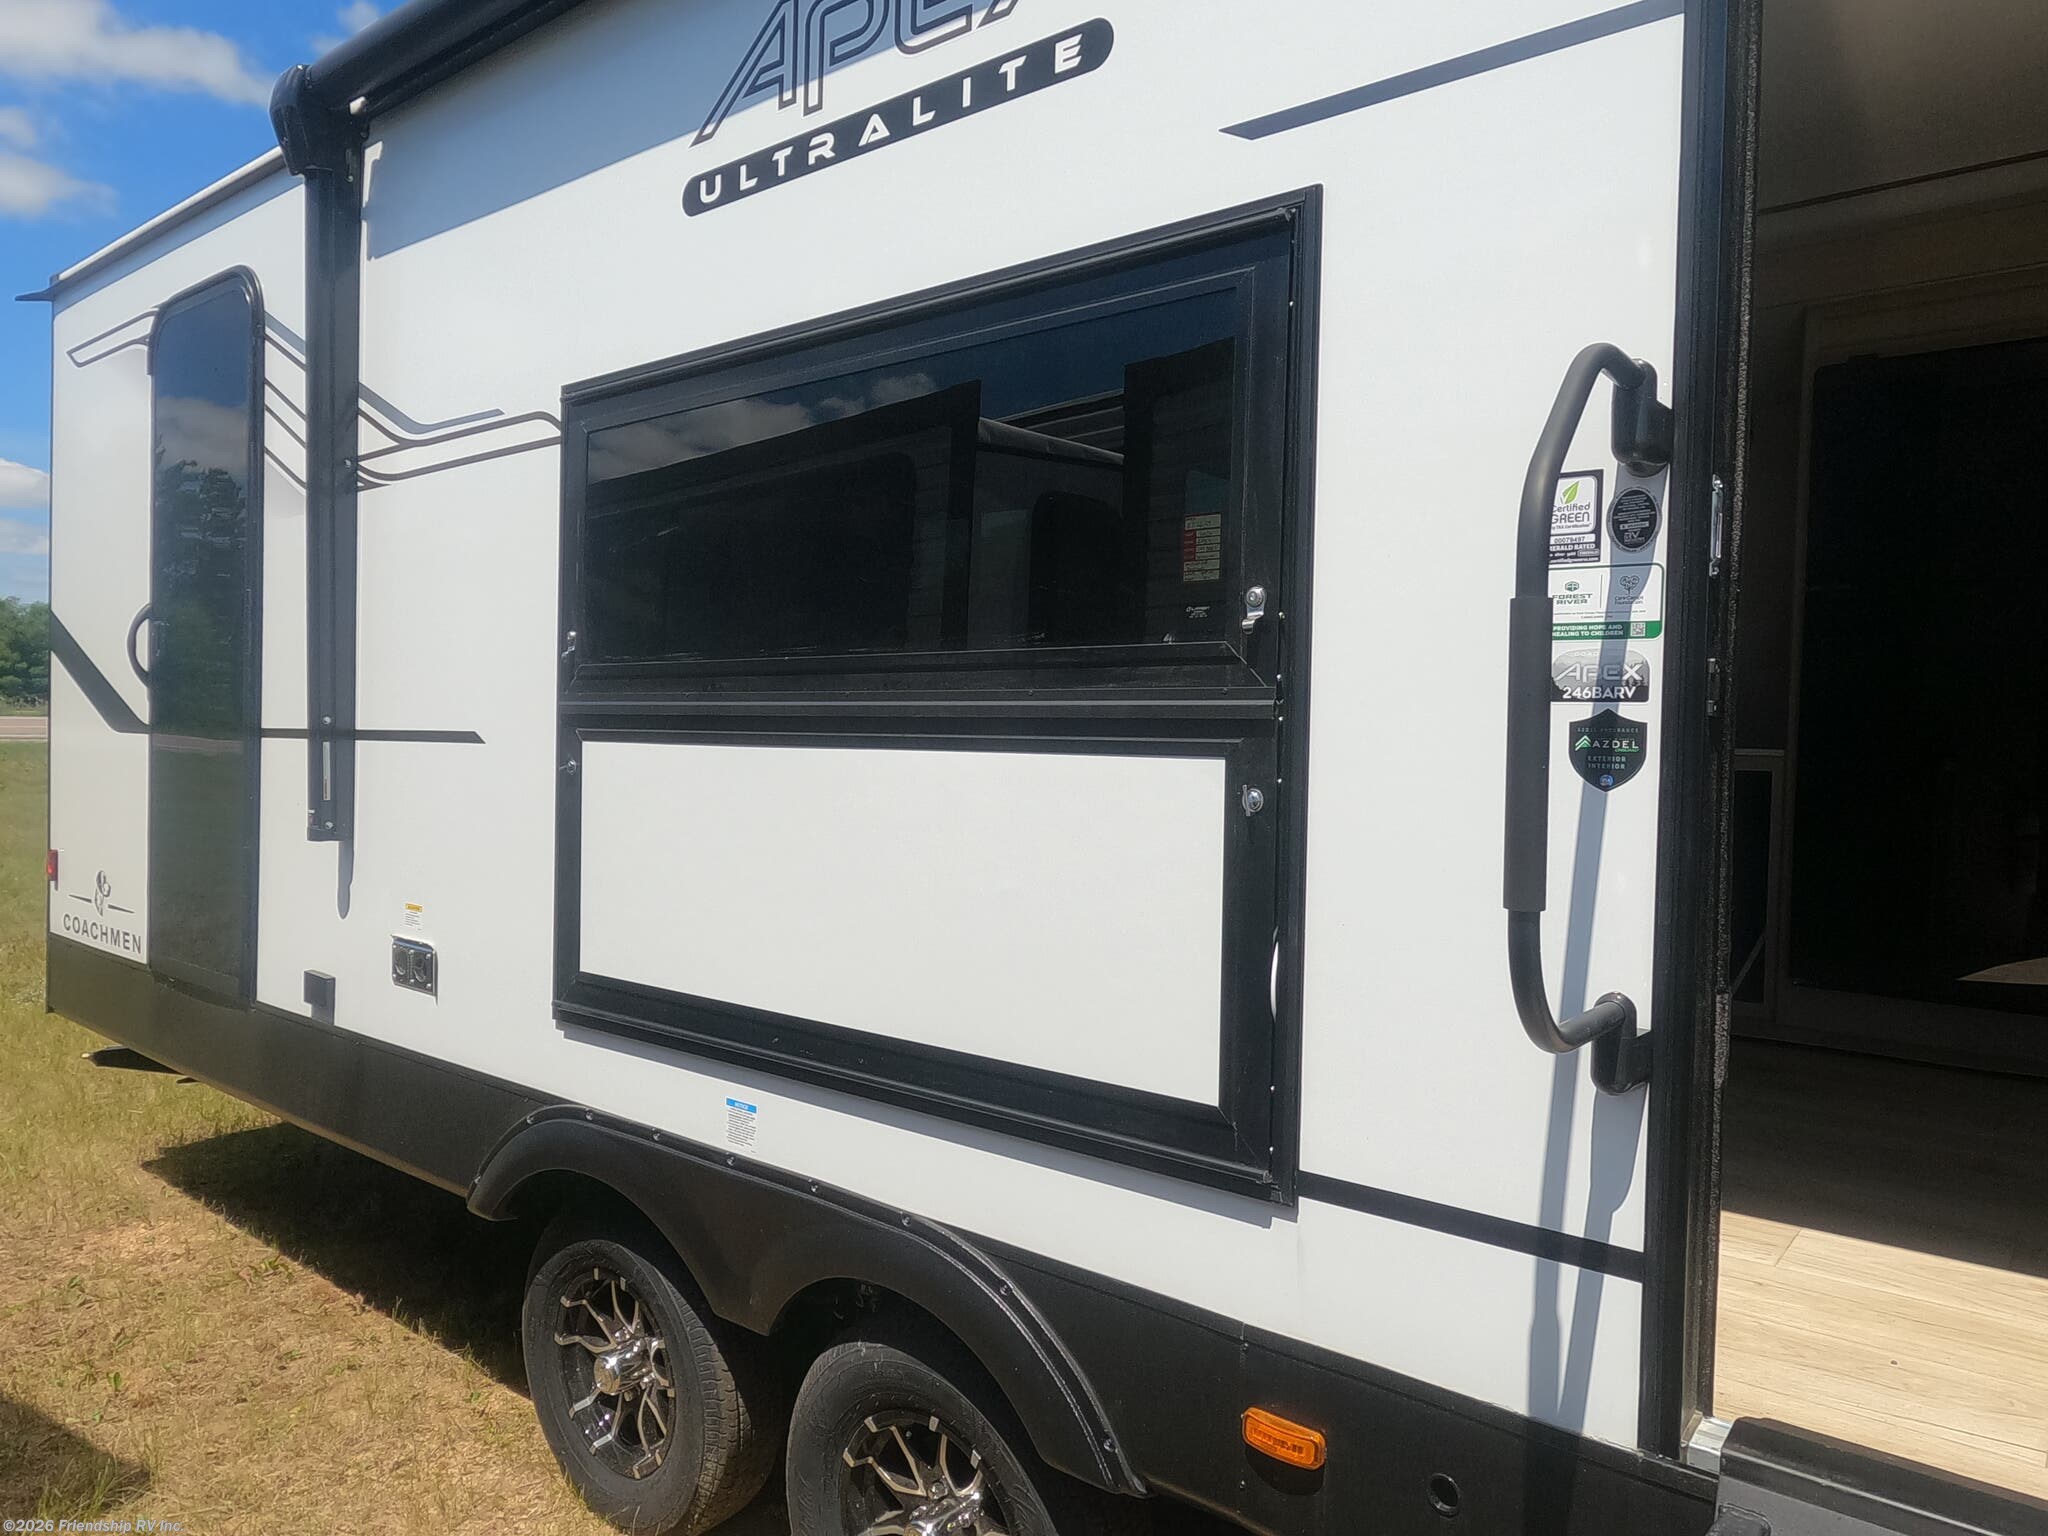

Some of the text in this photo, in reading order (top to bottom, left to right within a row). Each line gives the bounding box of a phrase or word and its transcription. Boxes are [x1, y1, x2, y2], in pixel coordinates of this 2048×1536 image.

[698, 32, 1085, 204] ULTRALITE
[1552, 501, 1591, 513] Certified
[1551, 511, 1590, 525] GREEN
[1550, 544, 1574, 552] ERALD
[1553, 624, 1588, 632] PROVIDING
[1554, 663, 1643, 683] APEX
[1562, 686, 1637, 699] 246BARV
[1592, 740, 1640, 749] AZDEL
[63, 913, 142, 954] COACHMEN
